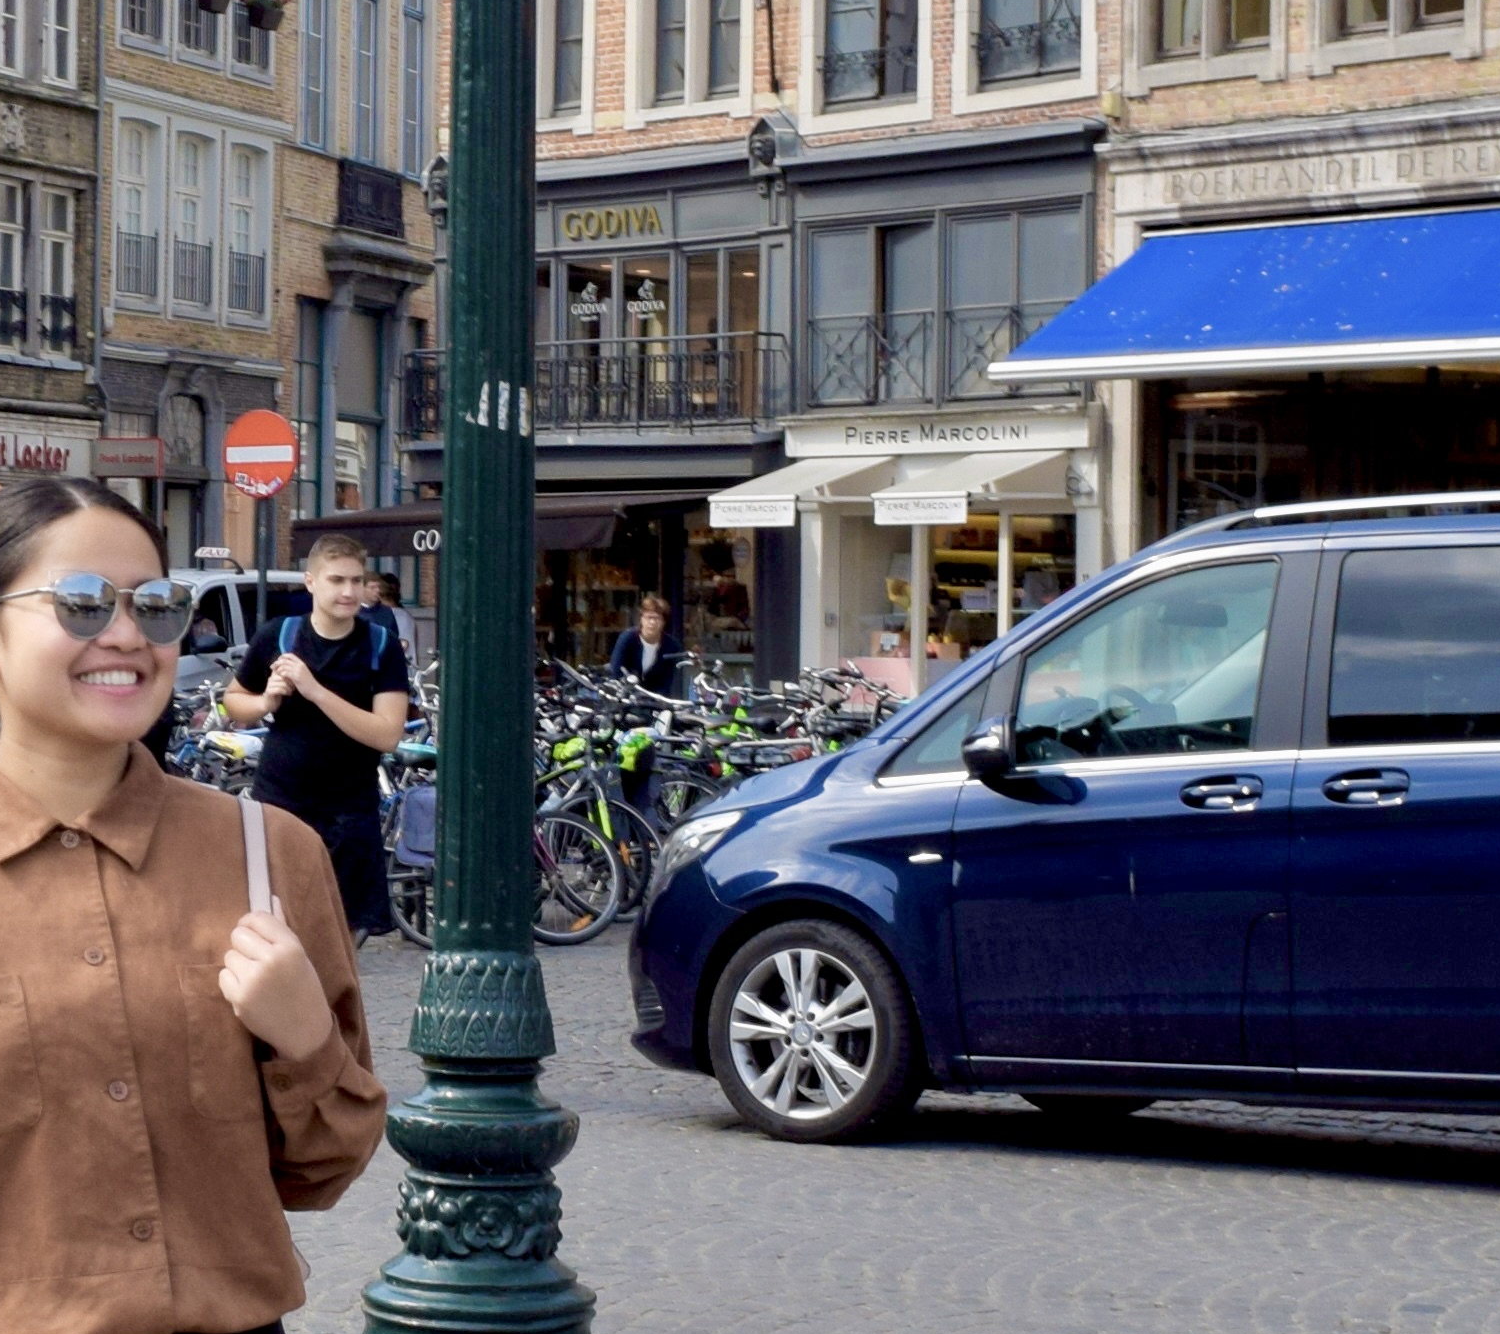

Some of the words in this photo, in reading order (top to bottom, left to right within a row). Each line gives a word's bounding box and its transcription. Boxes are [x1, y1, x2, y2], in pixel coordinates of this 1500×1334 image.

[1170, 156, 1382, 200] BOEKHANDEL
[1396, 149, 1435, 181] DE
[562, 205, 663, 242] GODIVA
[571, 301, 608, 315] GODIVA
[627, 299, 666, 312] GODIVA
[13, 433, 70, 472] Locker
[200, 547, 227, 557] TAXI
